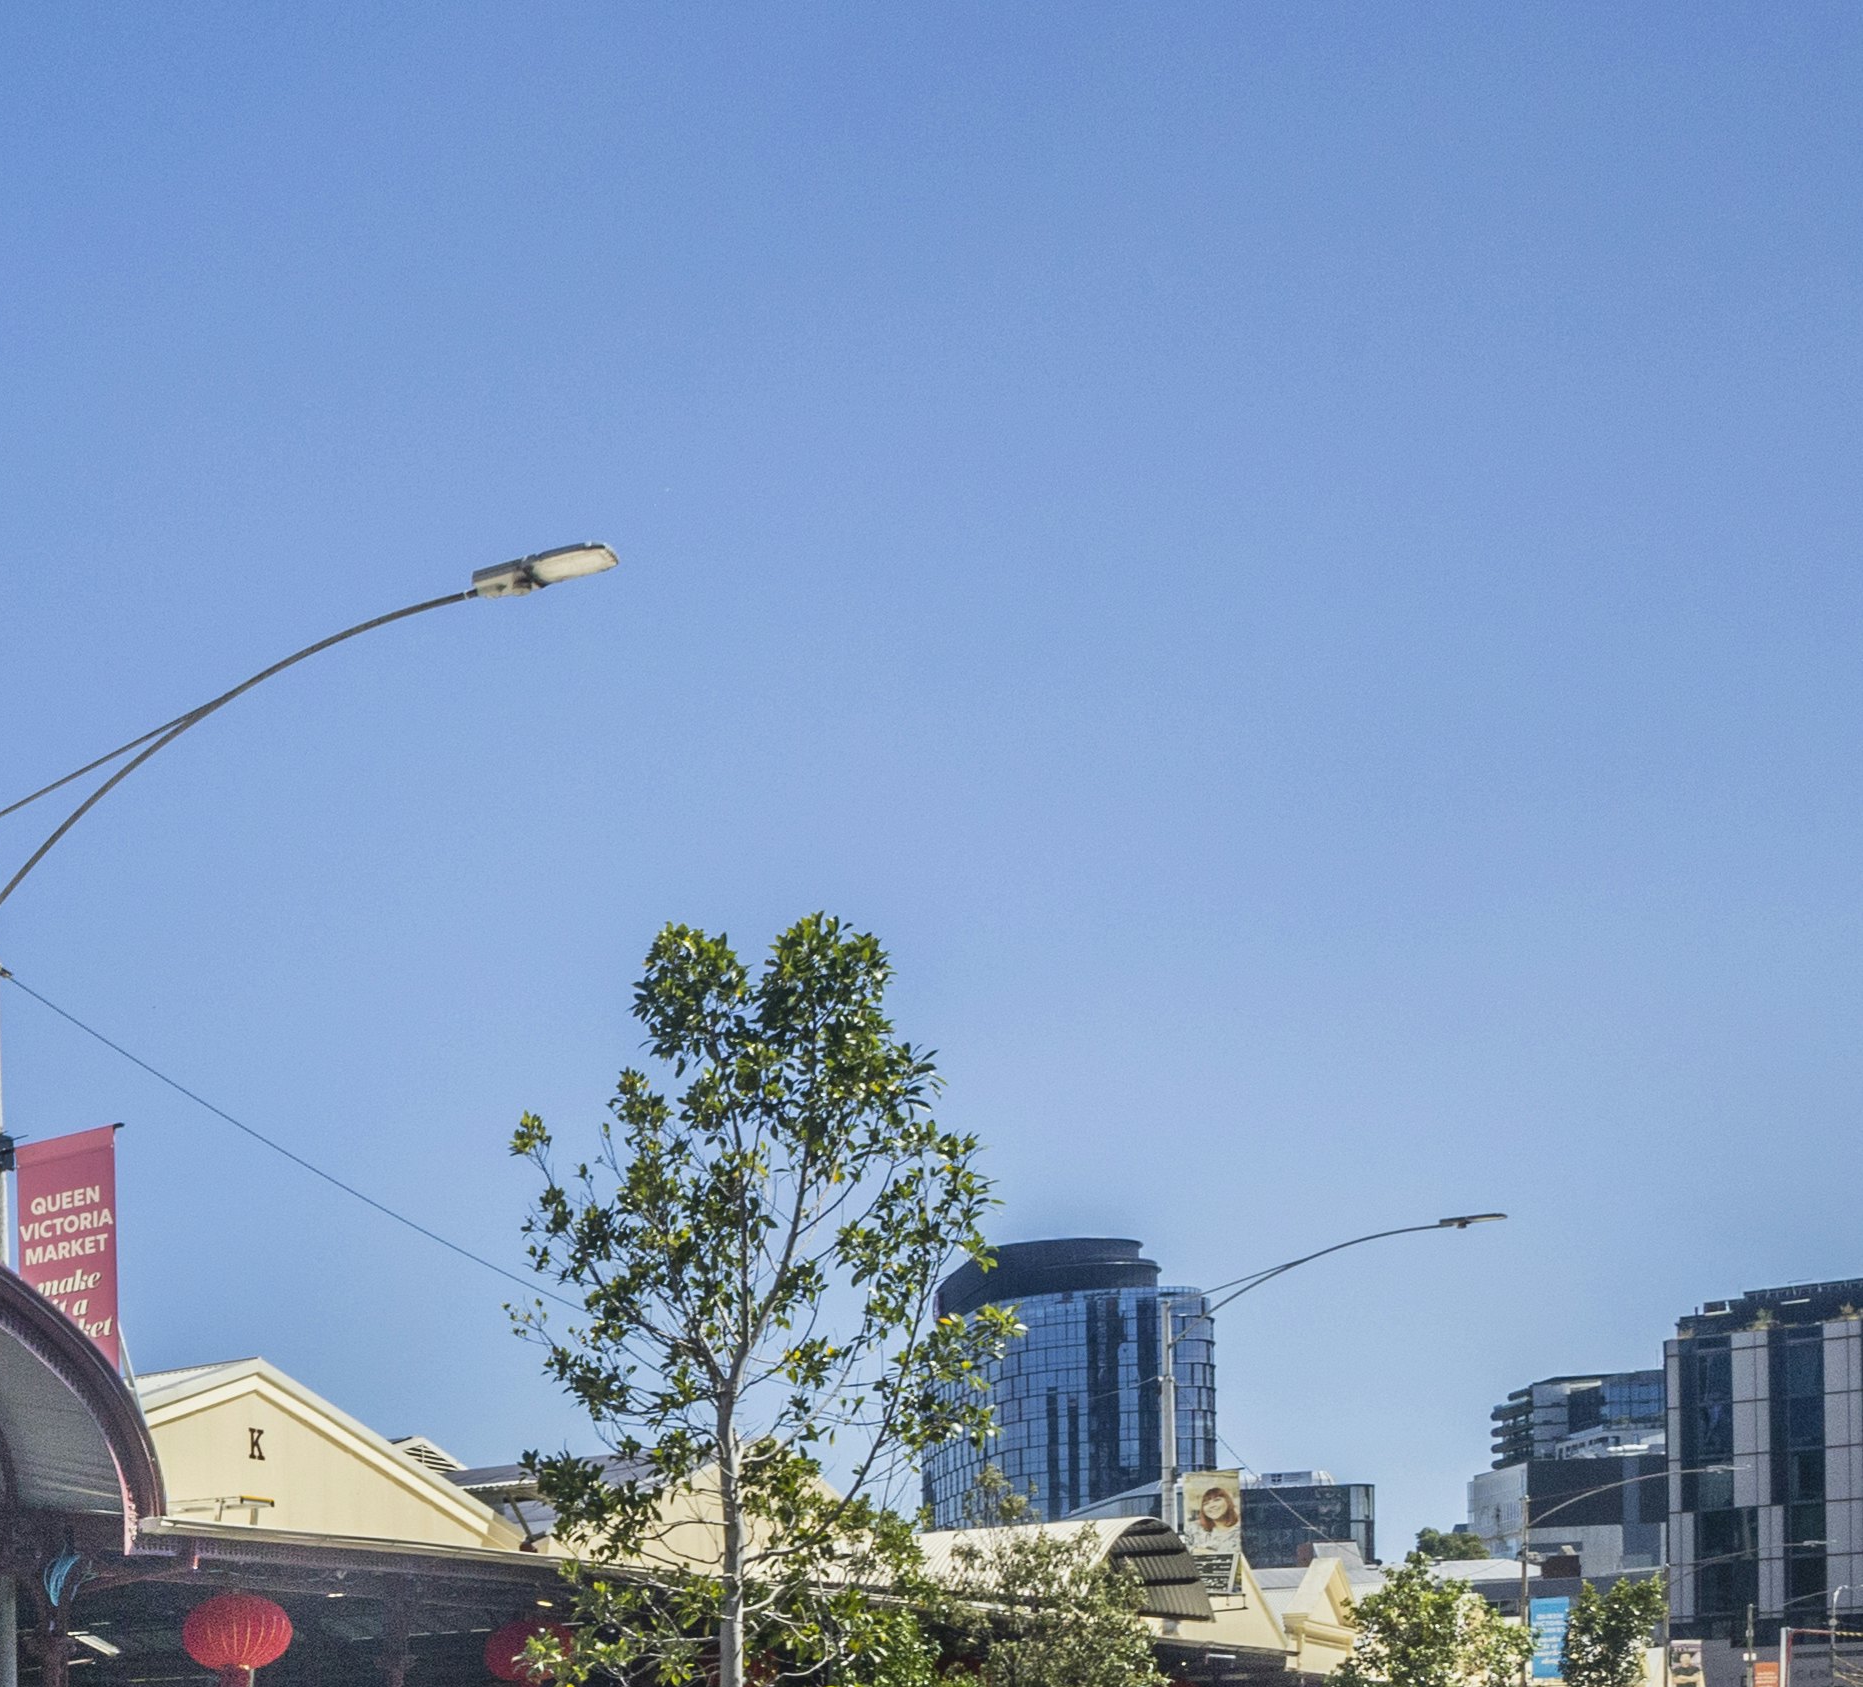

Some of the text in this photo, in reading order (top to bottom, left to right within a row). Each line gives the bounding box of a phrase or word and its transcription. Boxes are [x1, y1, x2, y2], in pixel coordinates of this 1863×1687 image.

[31, 1186, 100, 1215] QUEEN
[20, 1208, 113, 1242] VICTORIA
[25, 1233, 108, 1266] MARKET
[36, 1269, 101, 1296] make
[72, 1298, 88, 1316] a
[249, 1427, 265, 1461] K
